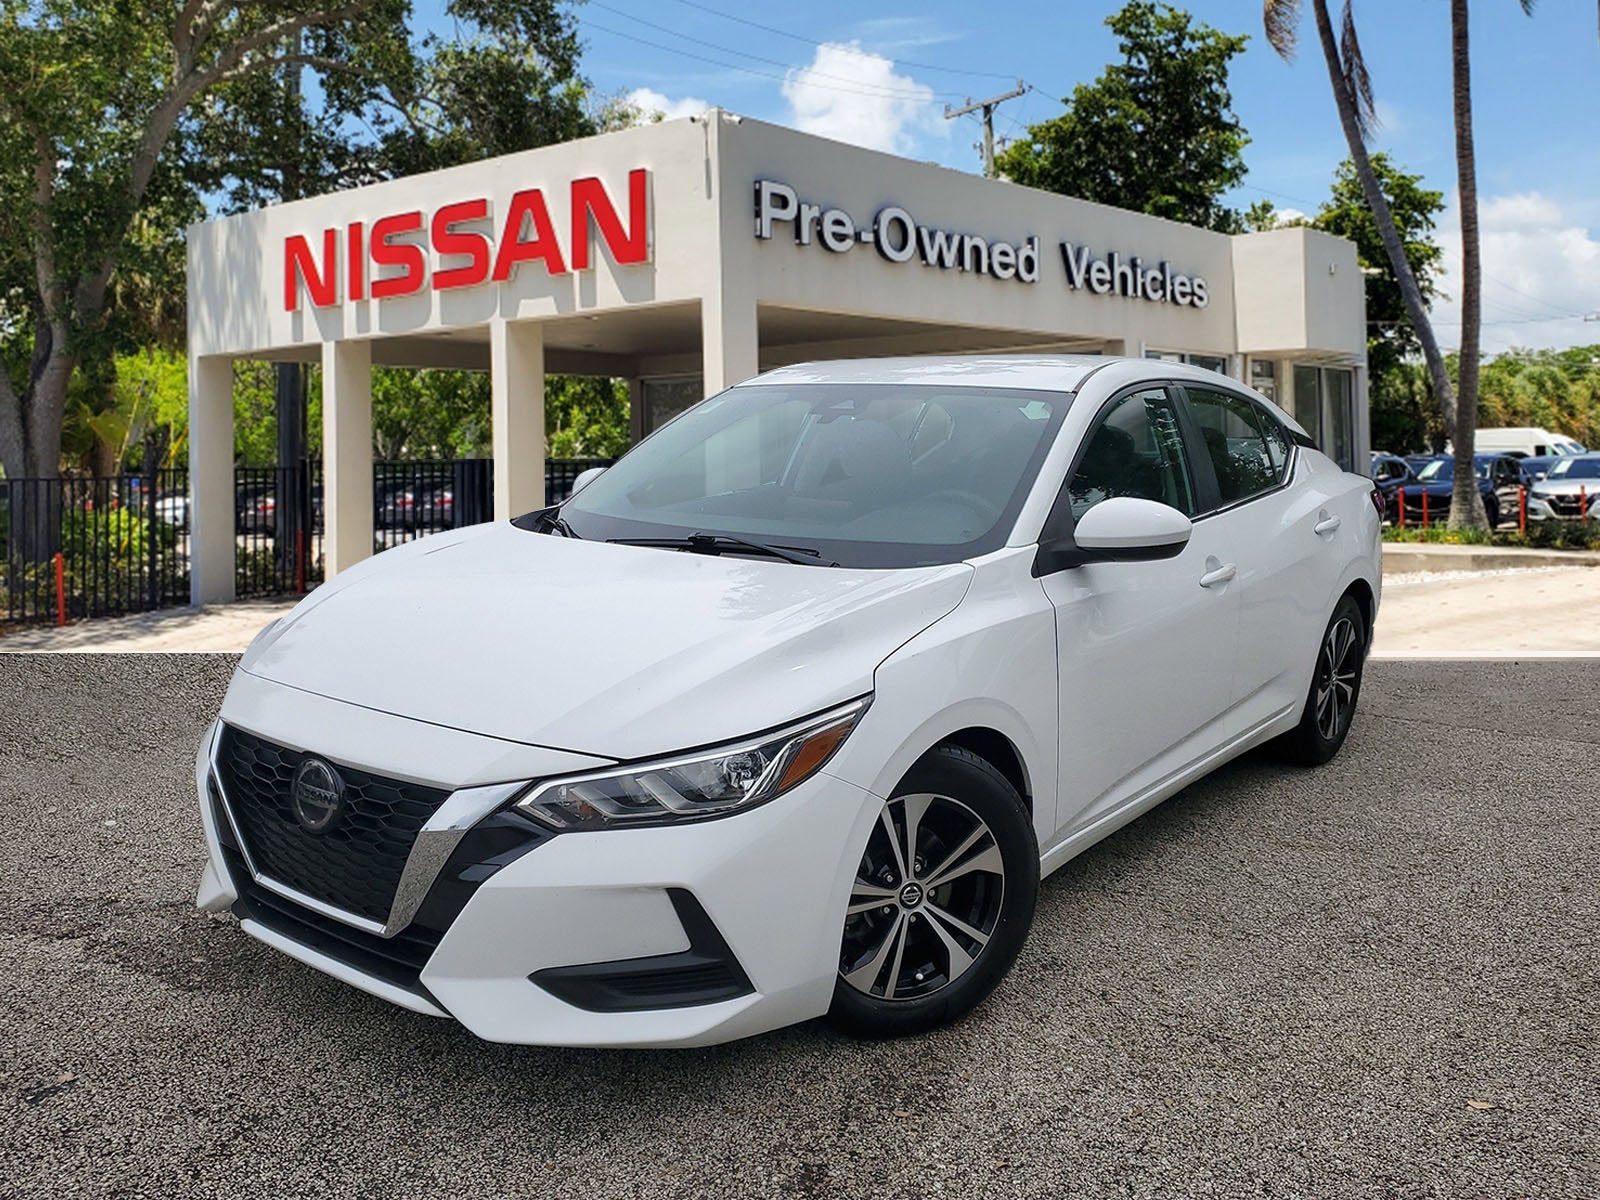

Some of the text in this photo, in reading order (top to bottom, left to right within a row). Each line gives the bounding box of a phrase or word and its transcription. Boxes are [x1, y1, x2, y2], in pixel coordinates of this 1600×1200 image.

[284, 168, 650, 312] NISSAN
[754, 180, 1209, 308] Pre-Owned Vehicles
